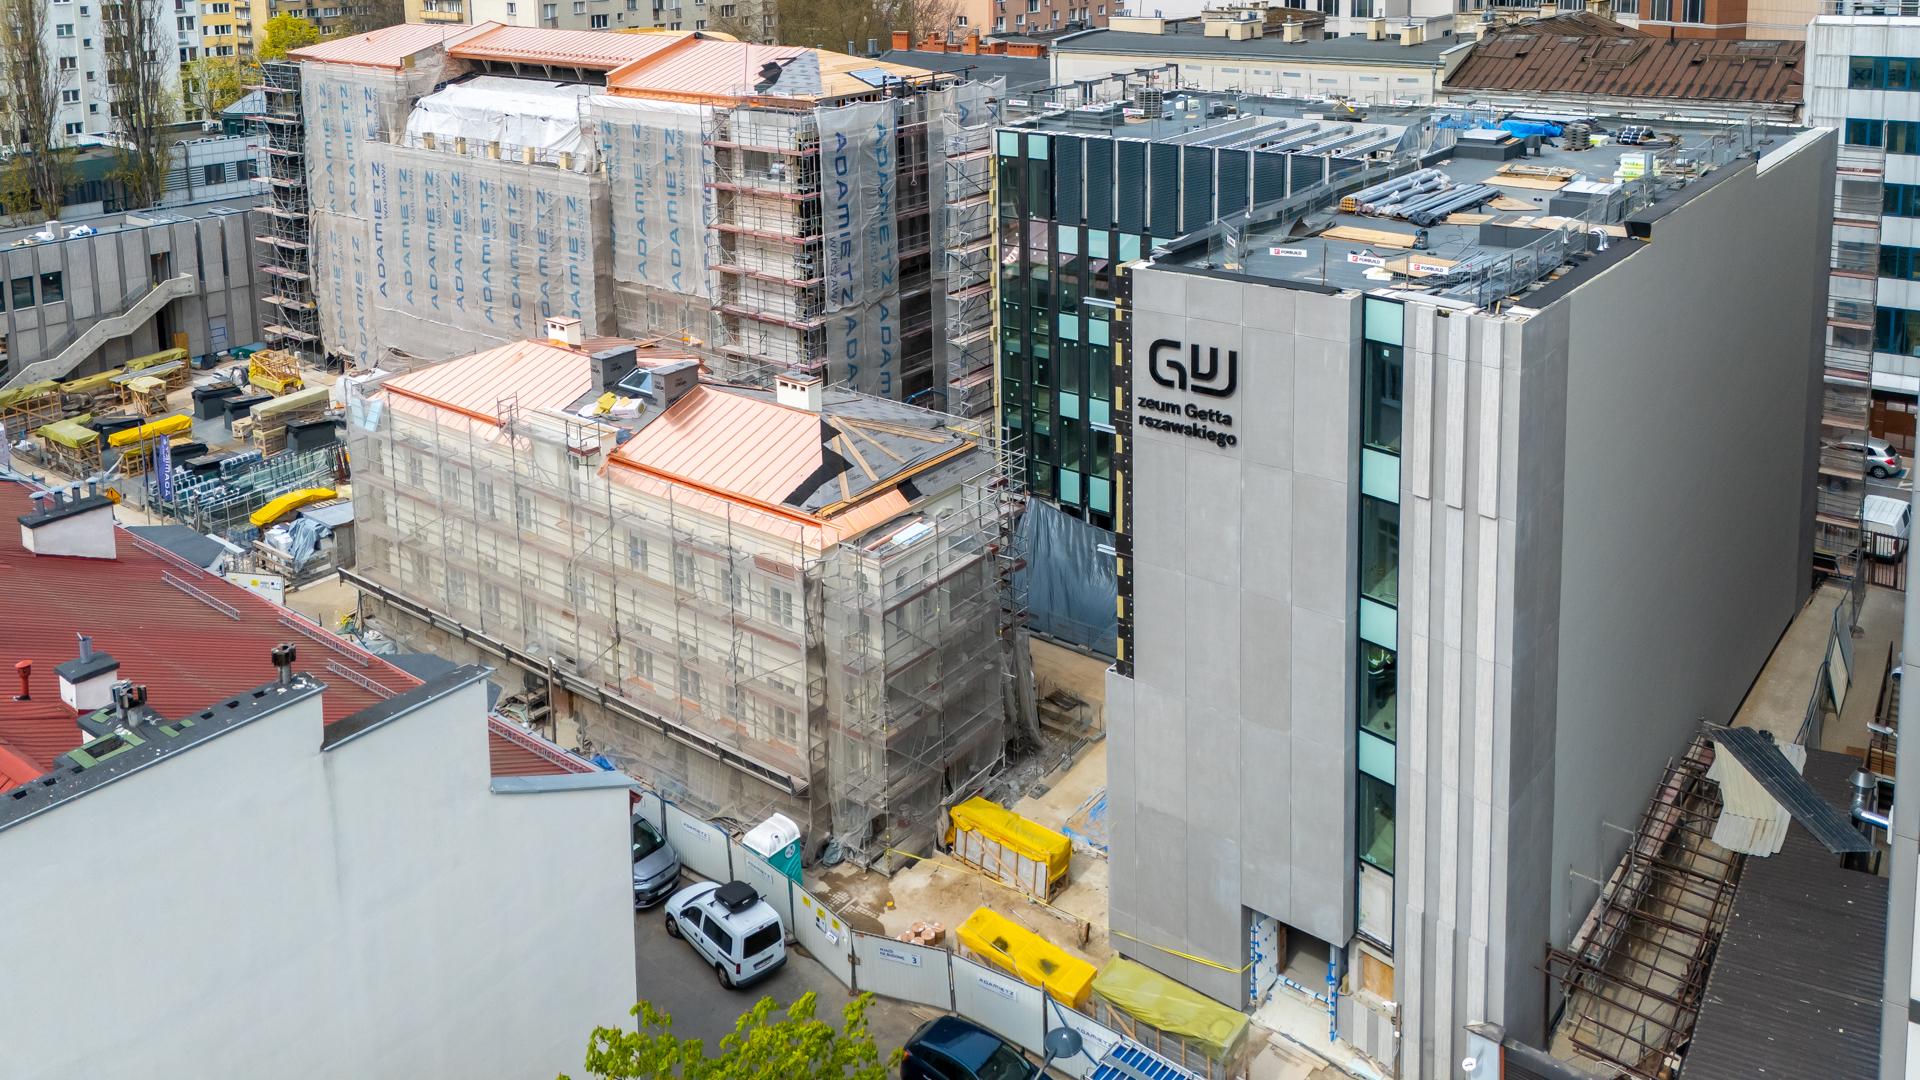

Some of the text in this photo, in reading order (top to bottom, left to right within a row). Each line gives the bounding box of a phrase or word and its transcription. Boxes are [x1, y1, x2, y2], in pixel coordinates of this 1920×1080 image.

[340, 83, 358, 214] ADAMIETZ
[632, 123, 648, 279] ADAMIETZ
[664, 128, 682, 290] ADAMIETZ
[371, 161, 388, 298] ADAMIETZ
[399, 168, 414, 305] ADAMIETZ
[425, 170, 440, 310] ADAMIETZ
[451, 172, 465, 312] ADAMIETZ
[480, 179, 494, 324] ADAMIETZ
[507, 183, 522, 329] ADAMIETZ
[566, 195, 580, 320] DAMIETZ
[834, 131, 854, 304] ADAMIETZ
[329, 229, 347, 341] DAMIETZ
[351, 235, 368, 366] ADAMIETZ
[1137, 396, 1233, 427] zeum Getta
[1138, 415, 1238, 448] rszawskiego
[912, 956, 917, 964] 3
[978, 977, 1015, 996] ADAMIETZ
[1076, 1026, 1113, 1048] ADAMIETZ
